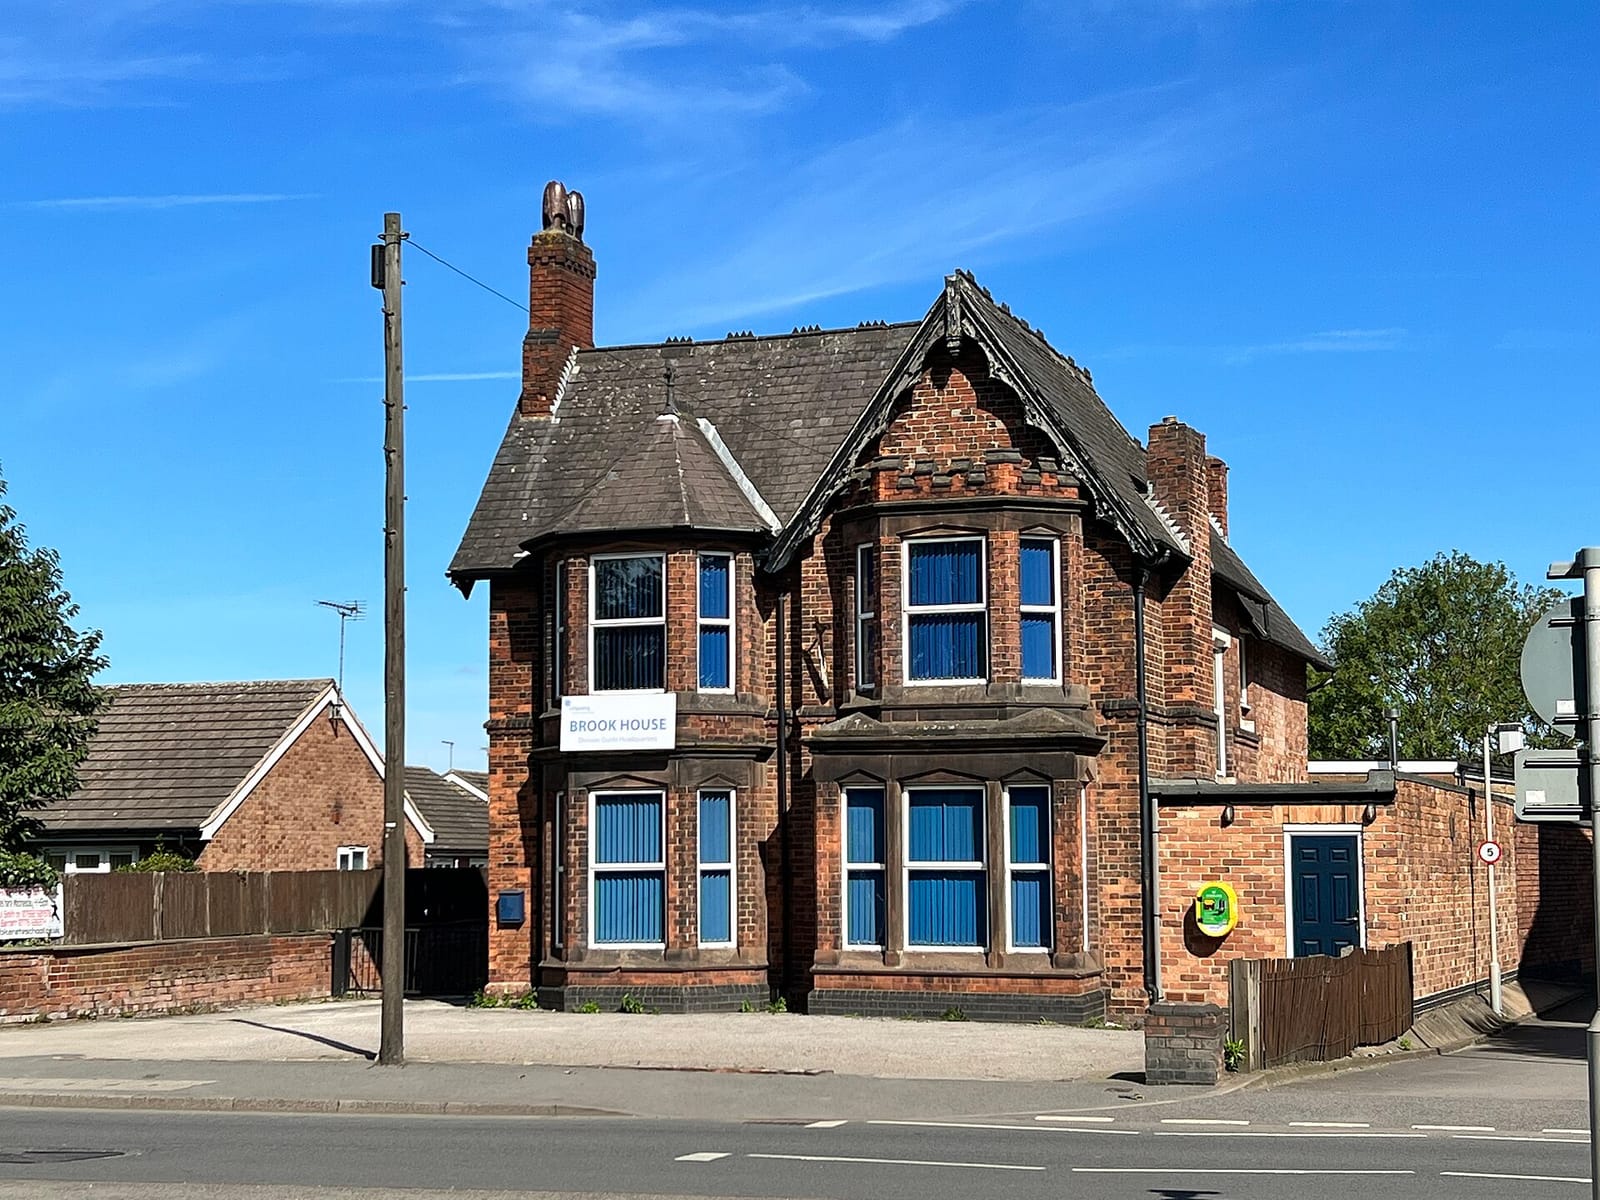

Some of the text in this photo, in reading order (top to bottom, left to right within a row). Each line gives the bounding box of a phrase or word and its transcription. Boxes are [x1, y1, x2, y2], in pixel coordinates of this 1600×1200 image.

[570, 718, 667, 732] BROOK HOUSE
[1487, 848, 1494, 857] 5
